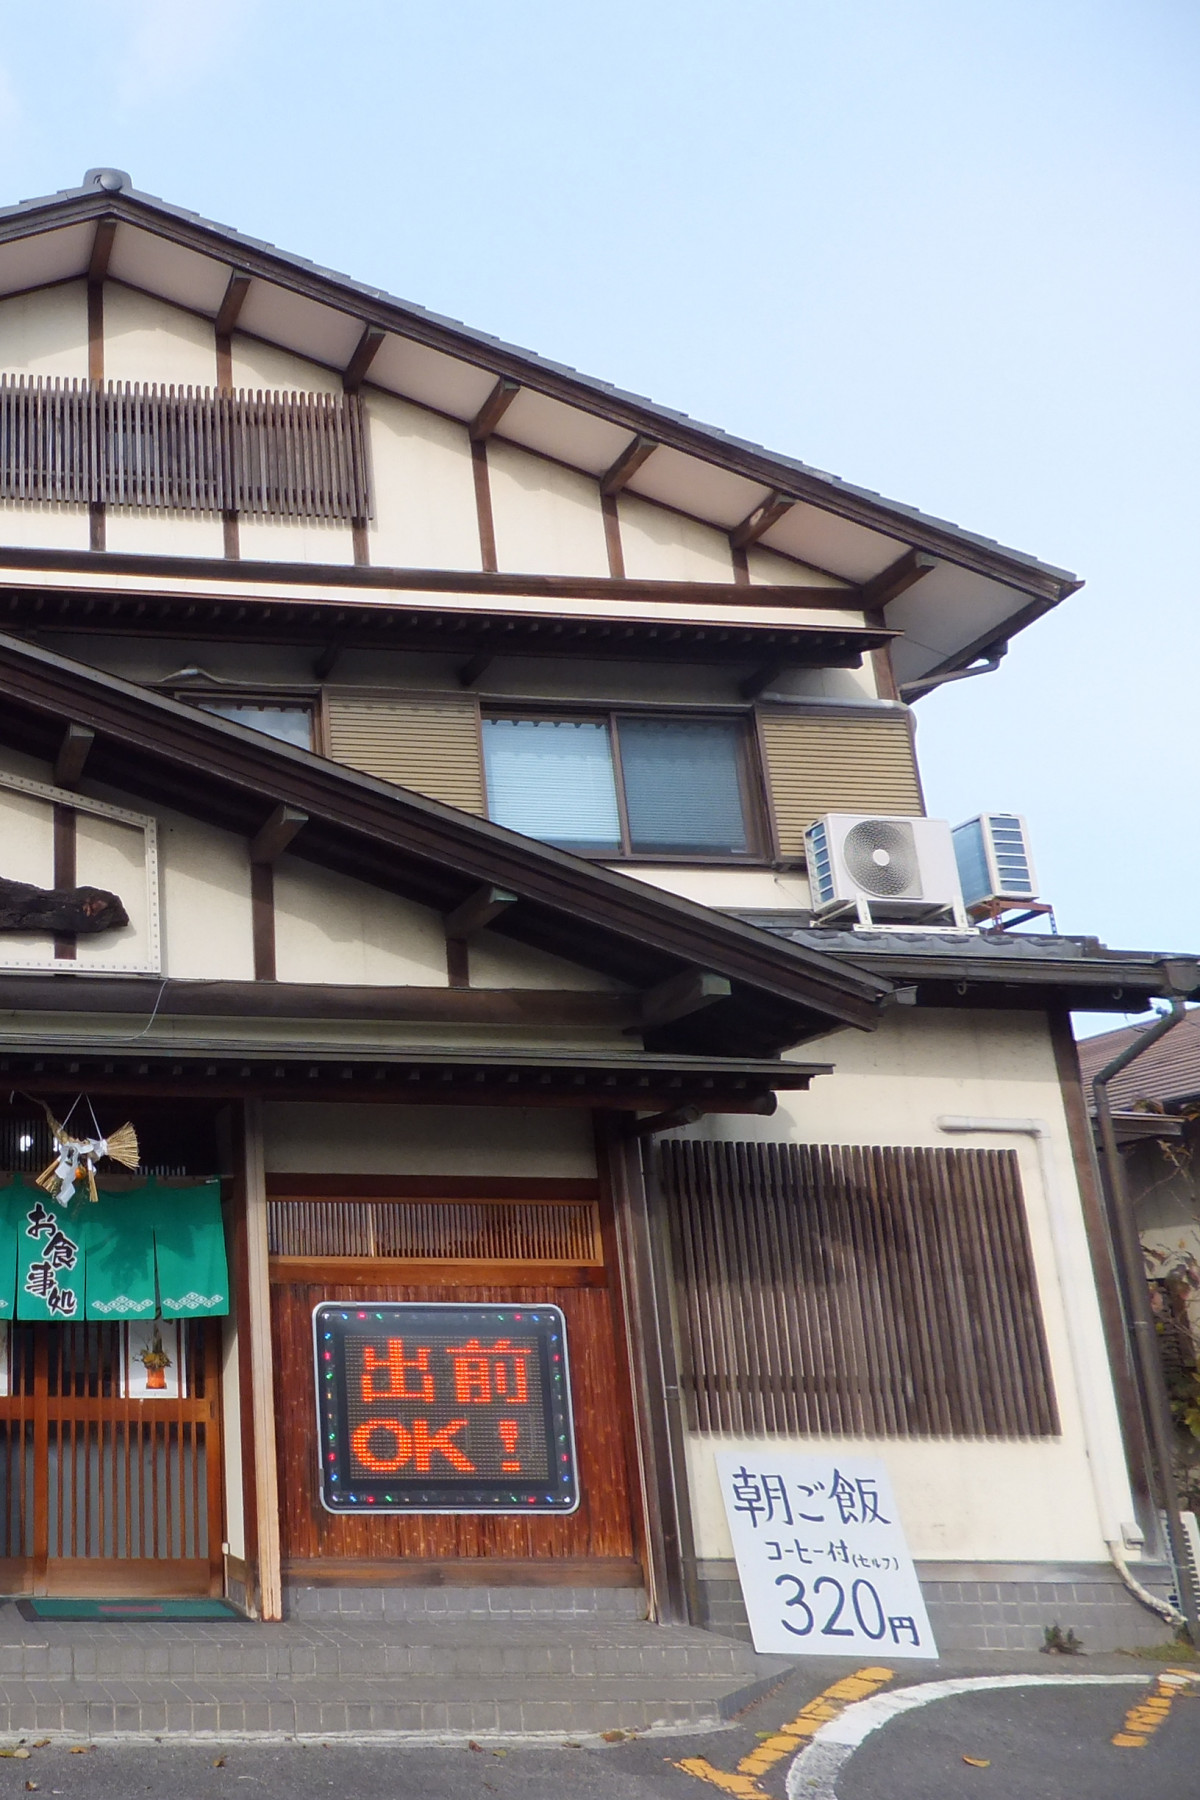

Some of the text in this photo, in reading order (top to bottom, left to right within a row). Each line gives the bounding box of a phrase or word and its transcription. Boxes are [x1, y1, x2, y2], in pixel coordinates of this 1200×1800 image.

[24, 1201, 79, 1317] お食事処
[360, 1337, 532, 1404] 出前
[732, 1465, 892, 1529] 朝ご飯
[774, 1573, 921, 1647] 320円
